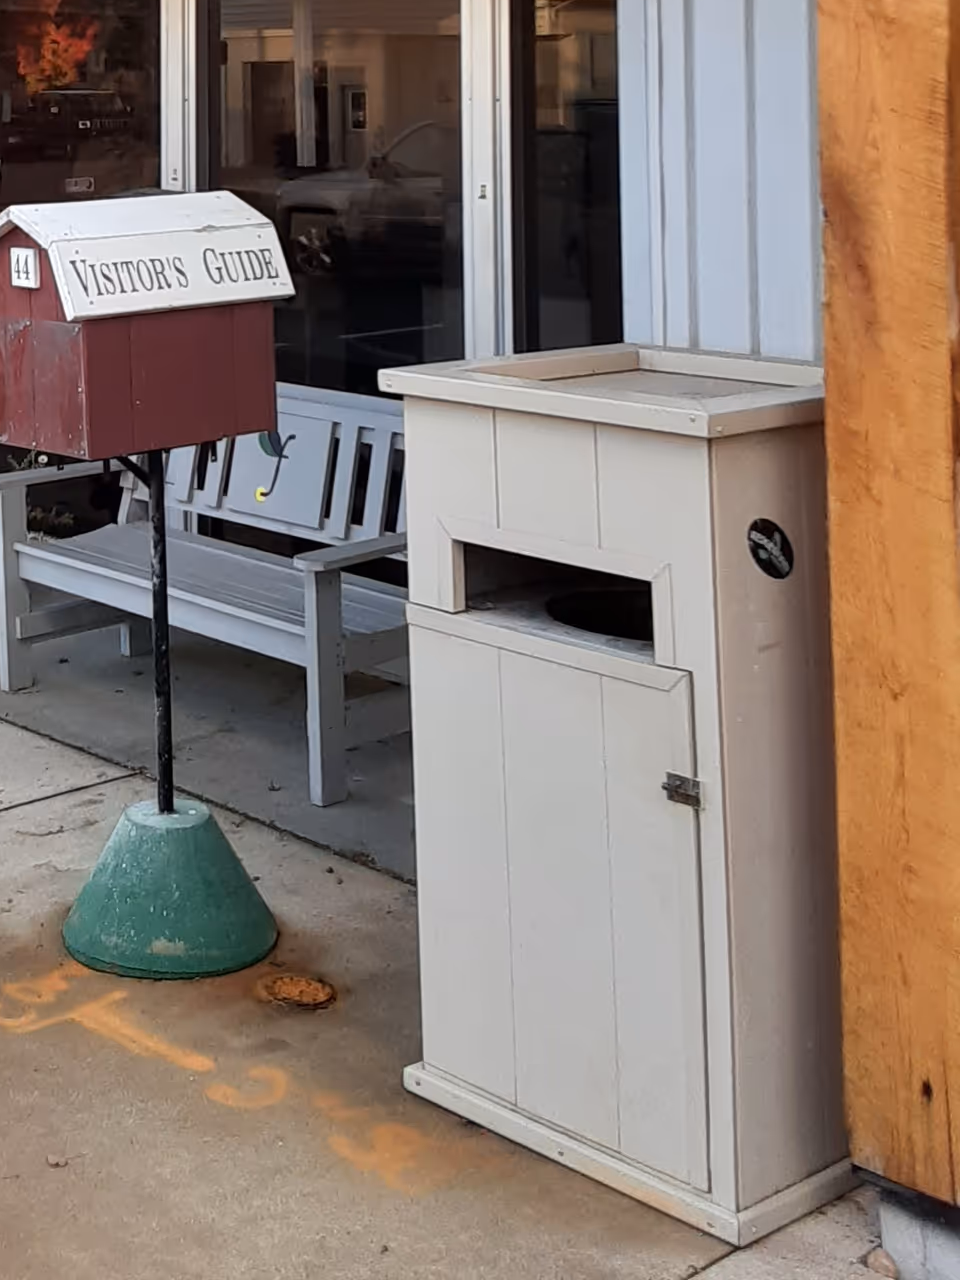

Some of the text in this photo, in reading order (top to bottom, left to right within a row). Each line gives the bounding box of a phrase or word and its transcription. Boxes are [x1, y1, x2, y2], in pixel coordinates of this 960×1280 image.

[14, 253, 31, 281] 44
[69, 248, 280, 298] VISITOR'S GUIDE
